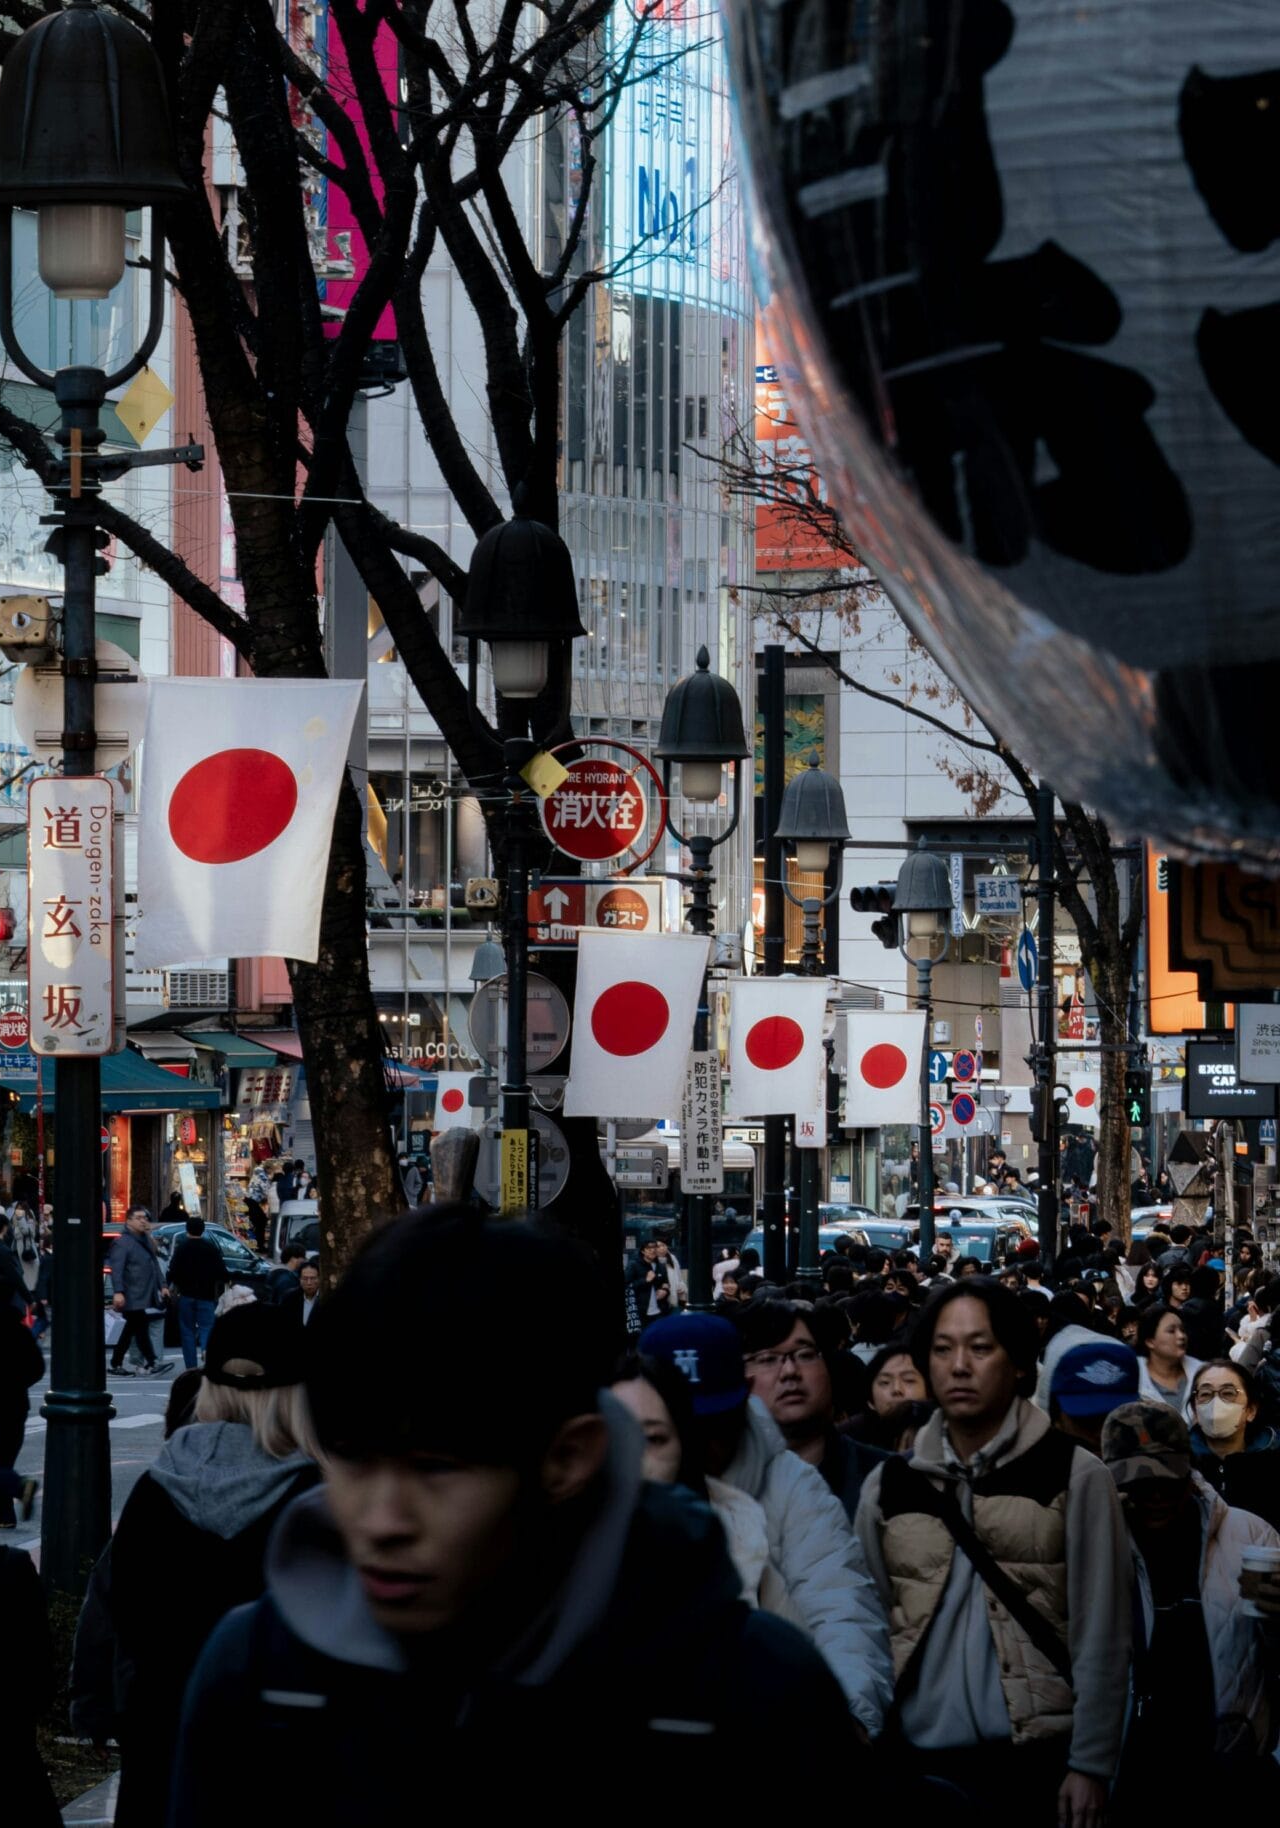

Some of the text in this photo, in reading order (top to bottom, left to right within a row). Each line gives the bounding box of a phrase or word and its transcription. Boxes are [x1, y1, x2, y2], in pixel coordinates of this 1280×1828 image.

[566, 772, 628, 786] IRE HYDRANT
[552, 790, 637, 830] 消火栓
[85, 806, 109, 945] Dougen-zaka
[43, 806, 82, 1028] 道玄坂
[603, 910, 644, 927] ガスト
[0, 1022, 28, 1037] 消火栓
[694, 1062, 710, 1173] 防犯カメラ作動中
[800, 1121, 815, 1137] 坂
